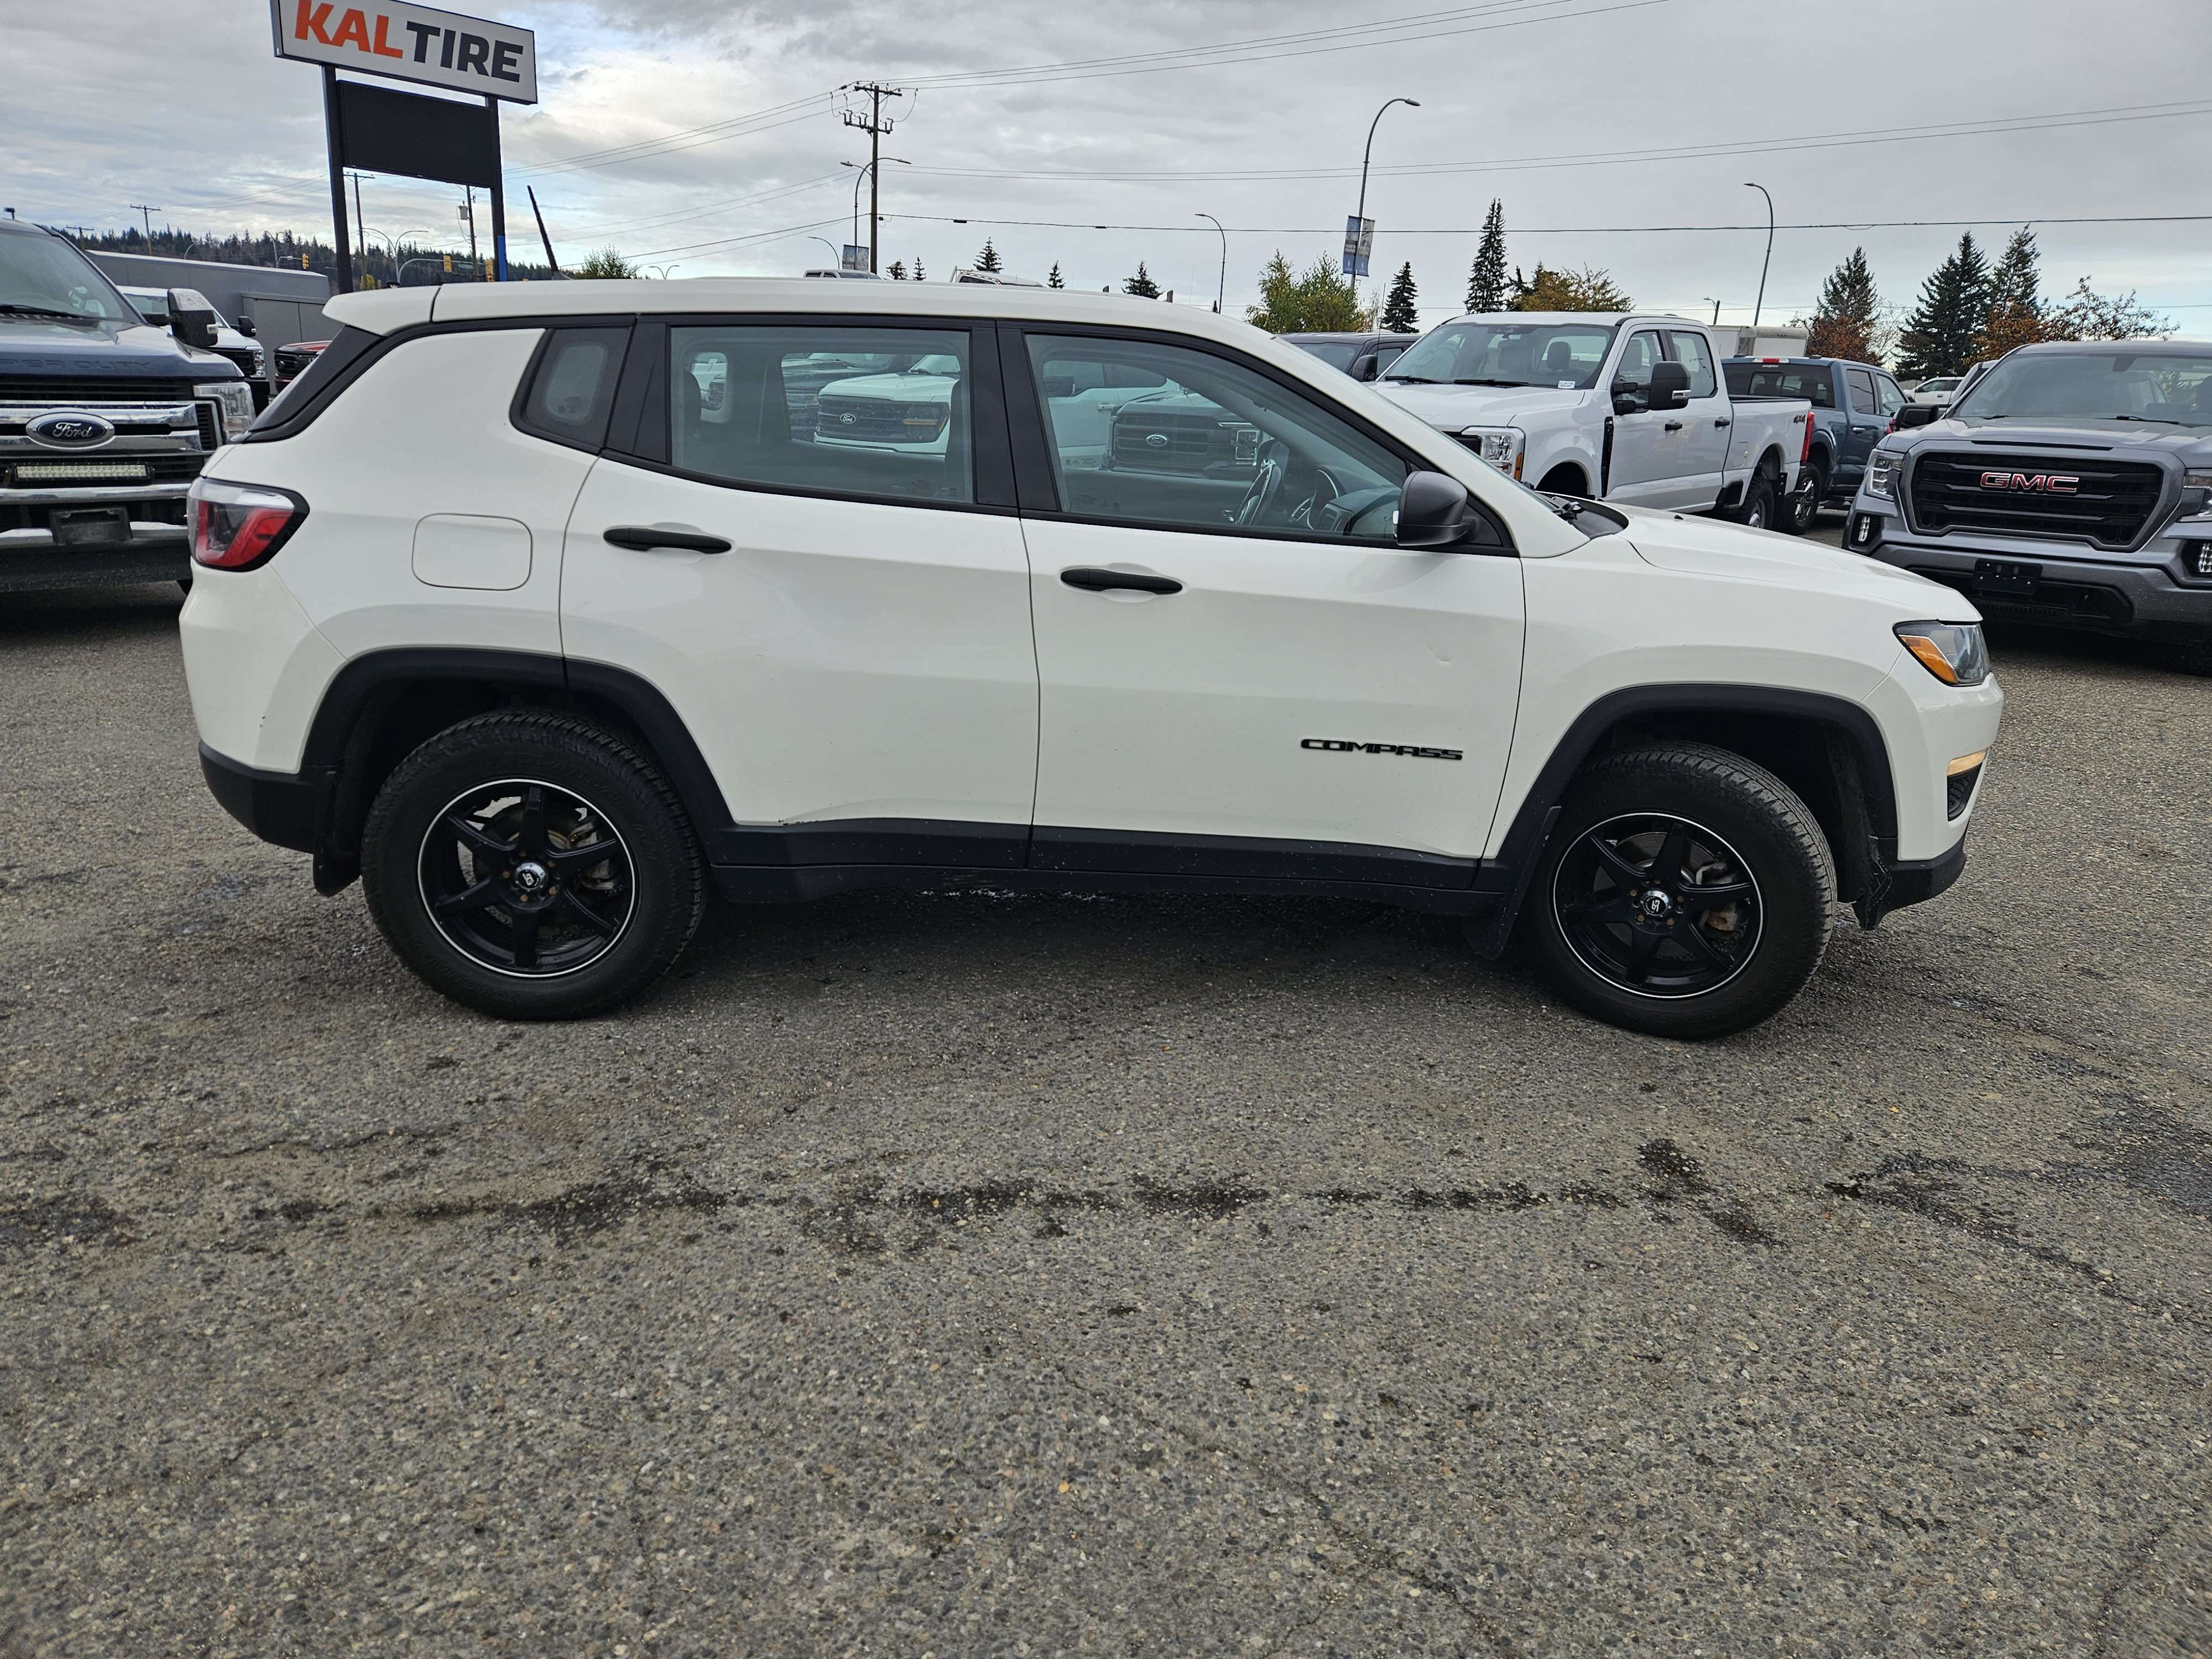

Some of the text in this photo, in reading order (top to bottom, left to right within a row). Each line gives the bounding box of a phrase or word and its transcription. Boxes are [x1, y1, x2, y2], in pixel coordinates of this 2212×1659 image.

[53, 422, 92, 437] Ford
[1980, 472, 2079, 493] GMC
[1301, 739, 1463, 760] COMPASS
